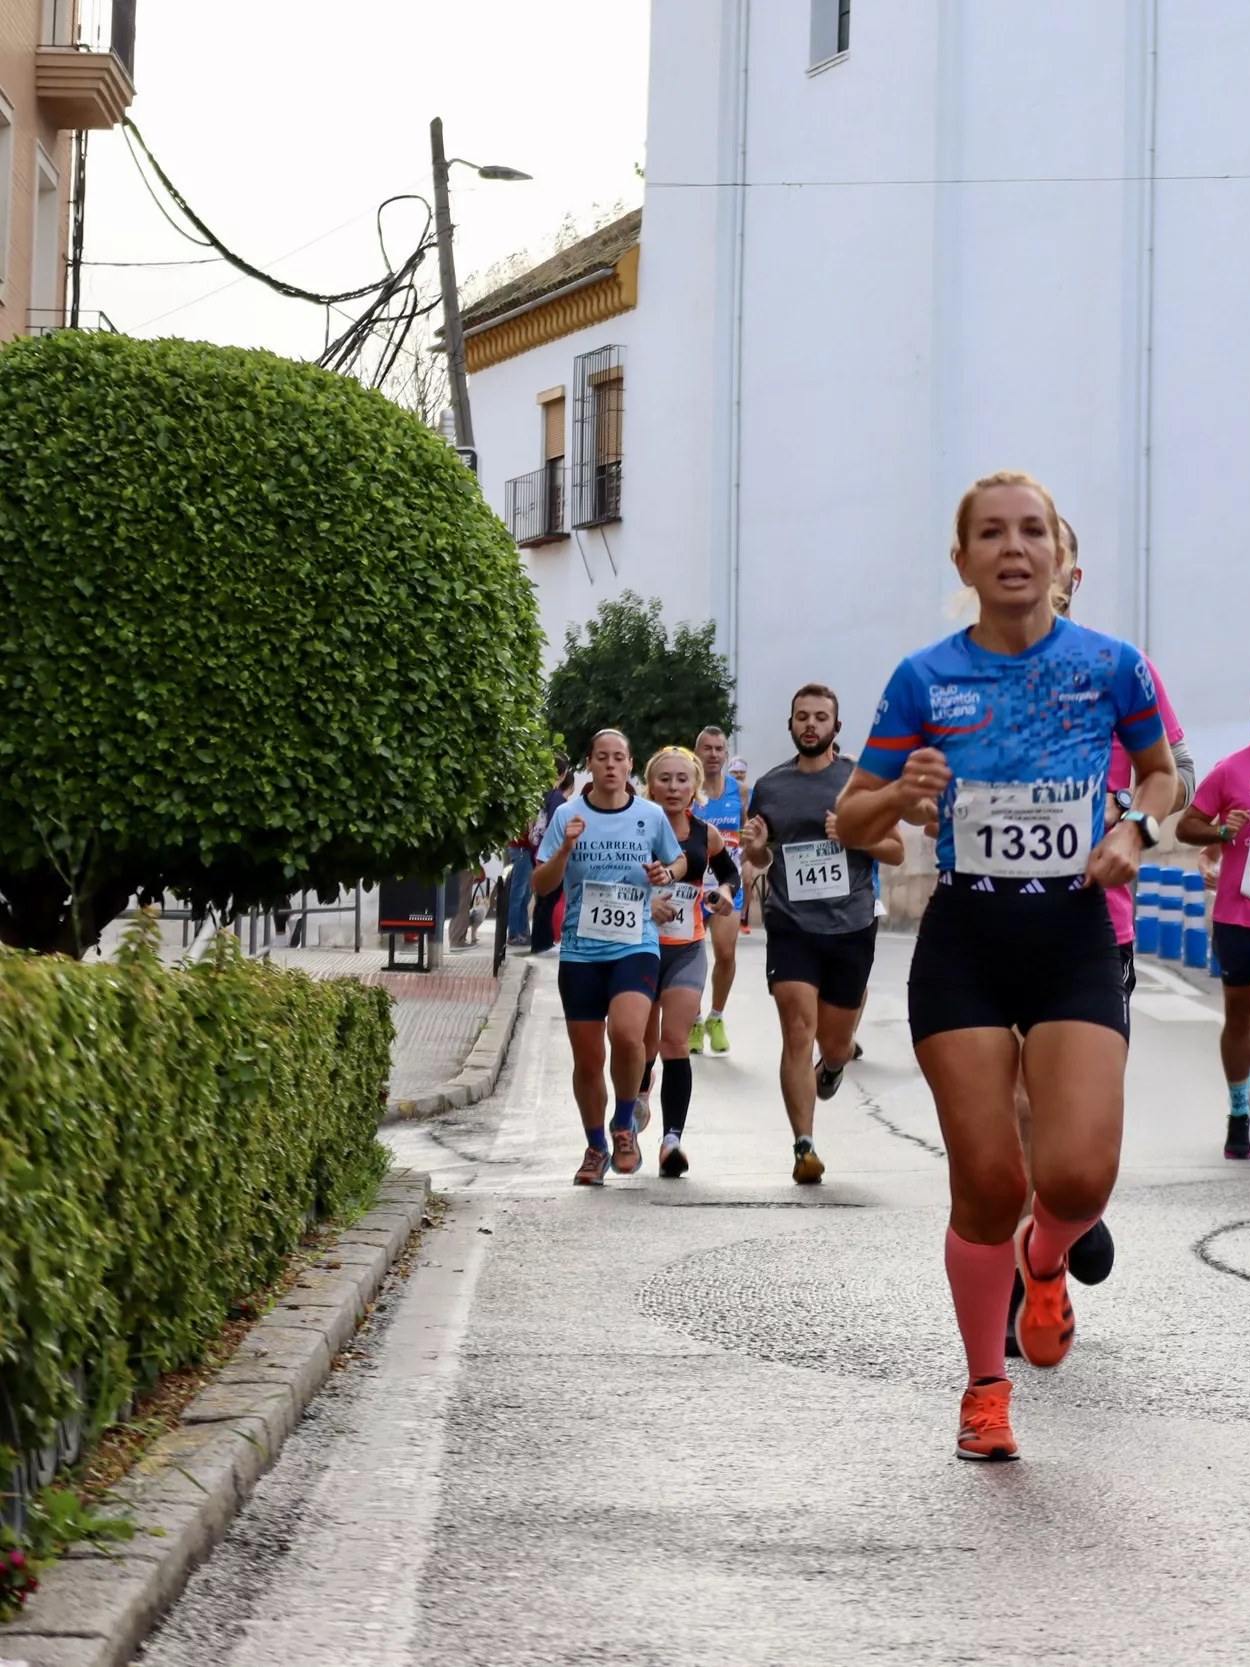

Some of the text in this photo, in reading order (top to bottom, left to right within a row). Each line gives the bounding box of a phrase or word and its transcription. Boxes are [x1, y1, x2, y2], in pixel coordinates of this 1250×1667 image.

[929, 684, 958, 697] Club
[930, 691, 980, 708] Maratón
[932, 705, 977, 721] Lucena
[590, 841, 643, 851] CARRERA
[976, 823, 1079, 860] 1330
[795, 864, 842, 886] 1415
[590, 906, 636, 928] 1393
